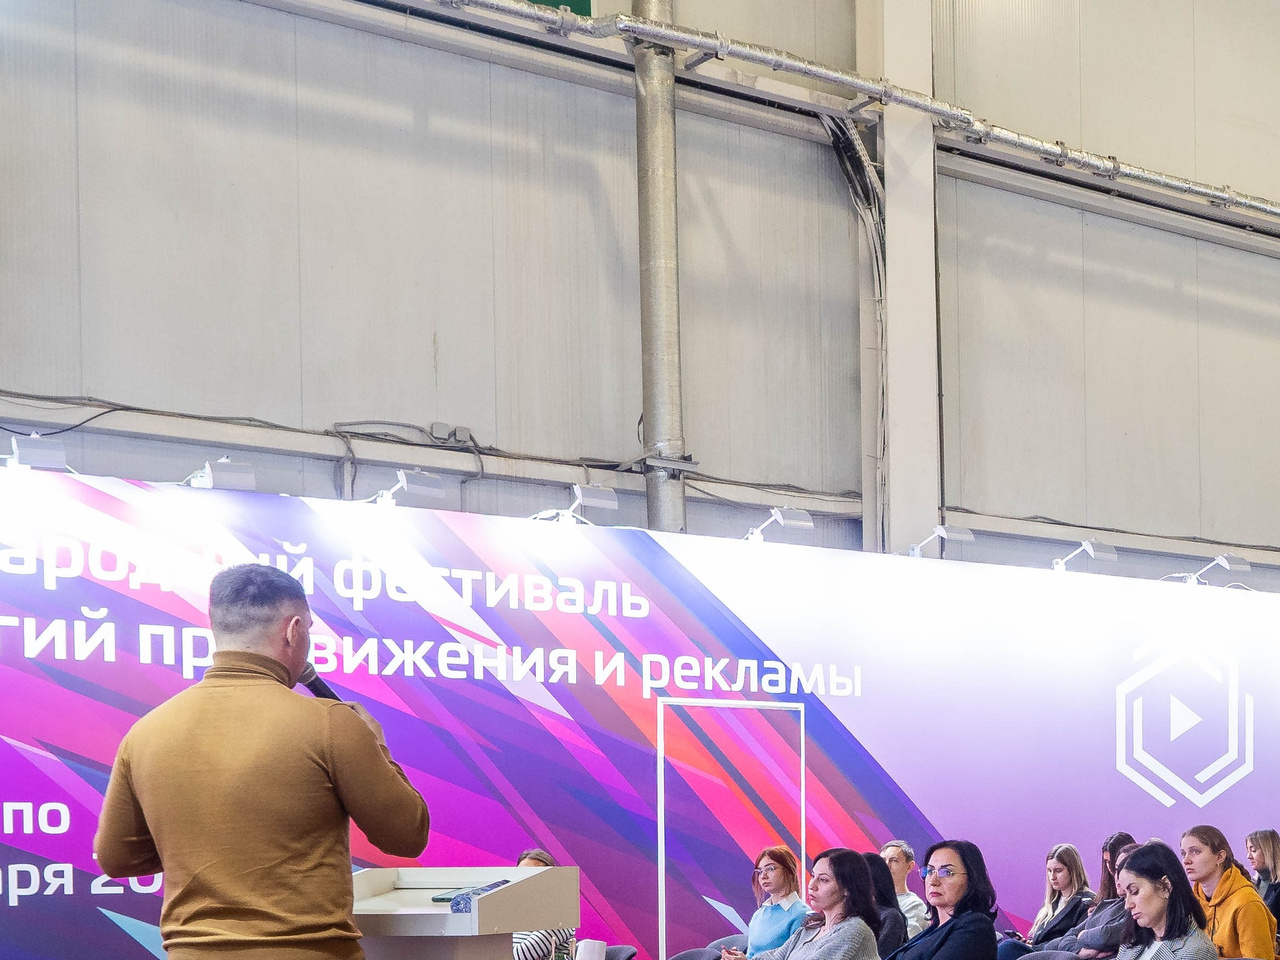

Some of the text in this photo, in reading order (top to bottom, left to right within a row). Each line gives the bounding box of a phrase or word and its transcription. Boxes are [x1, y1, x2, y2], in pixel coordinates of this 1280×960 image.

[333, 550, 650, 618] фетиваль
[0, 606, 862, 699] ий првижения и рекламы
[2, 801, 71, 835] по
[0, 863, 74, 907] ря
